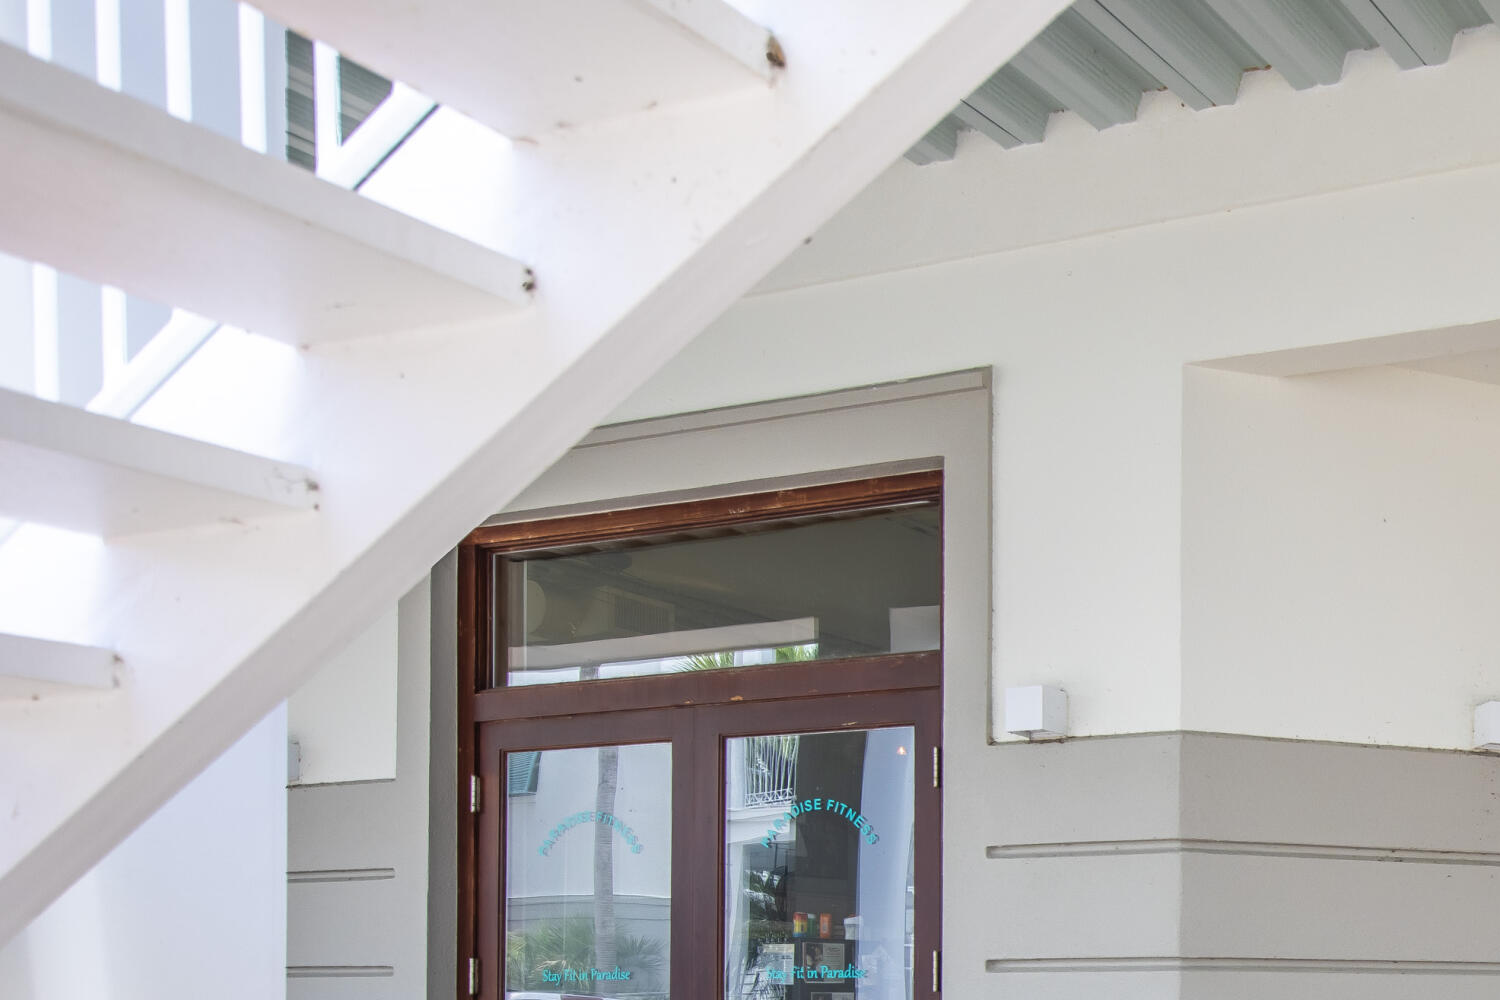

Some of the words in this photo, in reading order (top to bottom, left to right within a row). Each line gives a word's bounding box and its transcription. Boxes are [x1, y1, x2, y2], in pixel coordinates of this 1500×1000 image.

[825, 799, 880, 845] FITNESS
[541, 968, 561, 986] Stay
[562, 967, 578, 981] Fit
[578, 967, 589, 981] in
[590, 964, 632, 982] Paradise
[806, 966, 819, 979] in
[819, 962, 868, 979] Paradise
